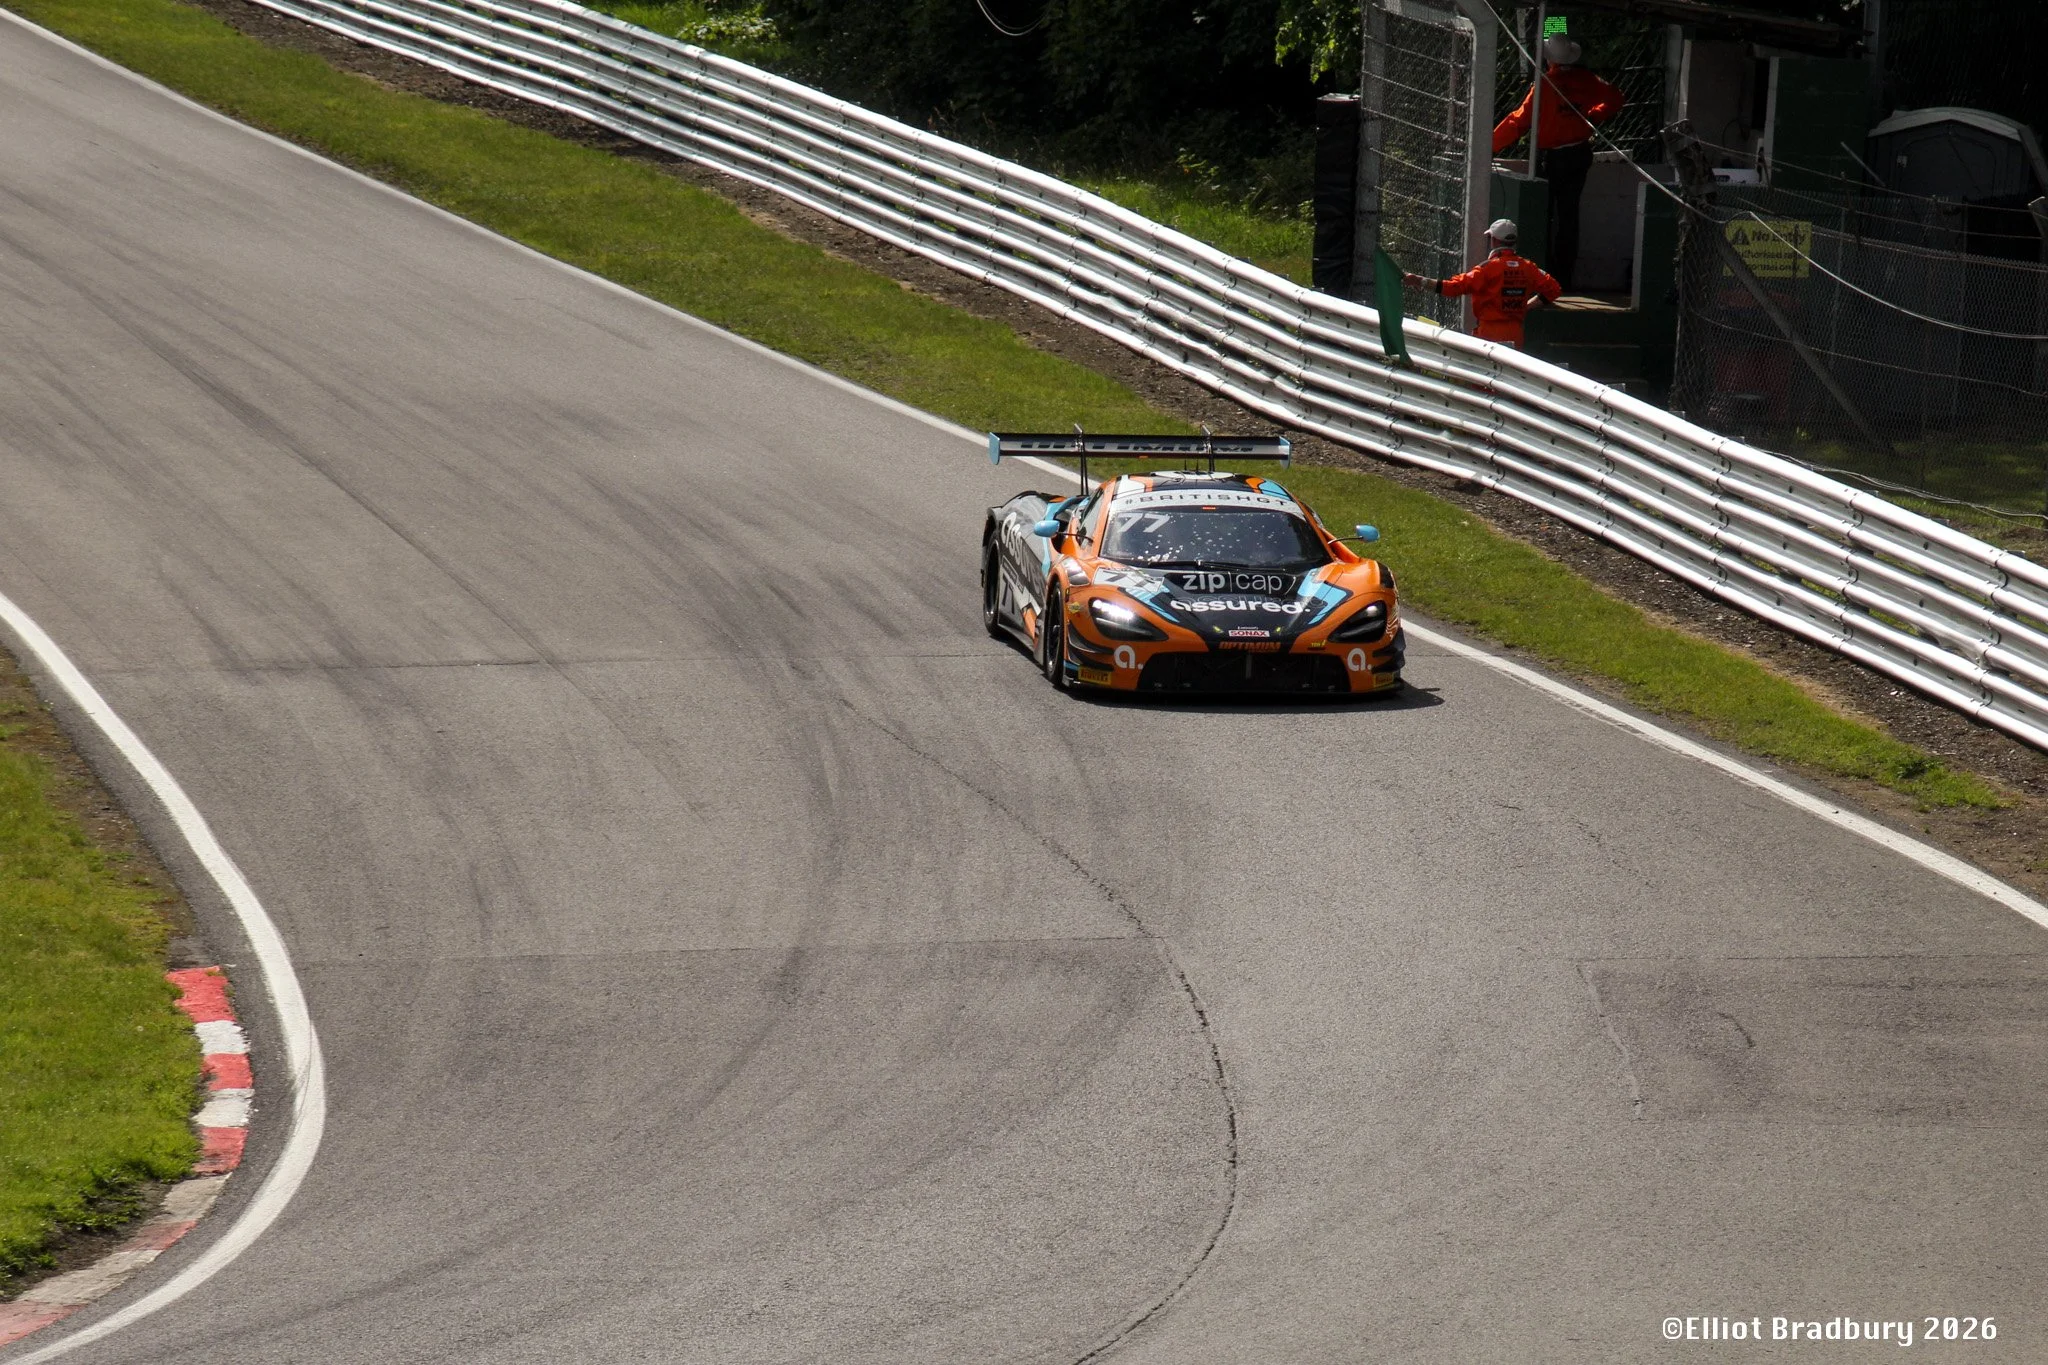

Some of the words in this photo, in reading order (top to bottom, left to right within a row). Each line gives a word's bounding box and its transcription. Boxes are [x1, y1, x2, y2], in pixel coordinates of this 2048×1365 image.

[1752, 231, 1769, 241] No
[1125, 494, 1288, 506] #BRITISHGT
[1117, 513, 1171, 533] 77
